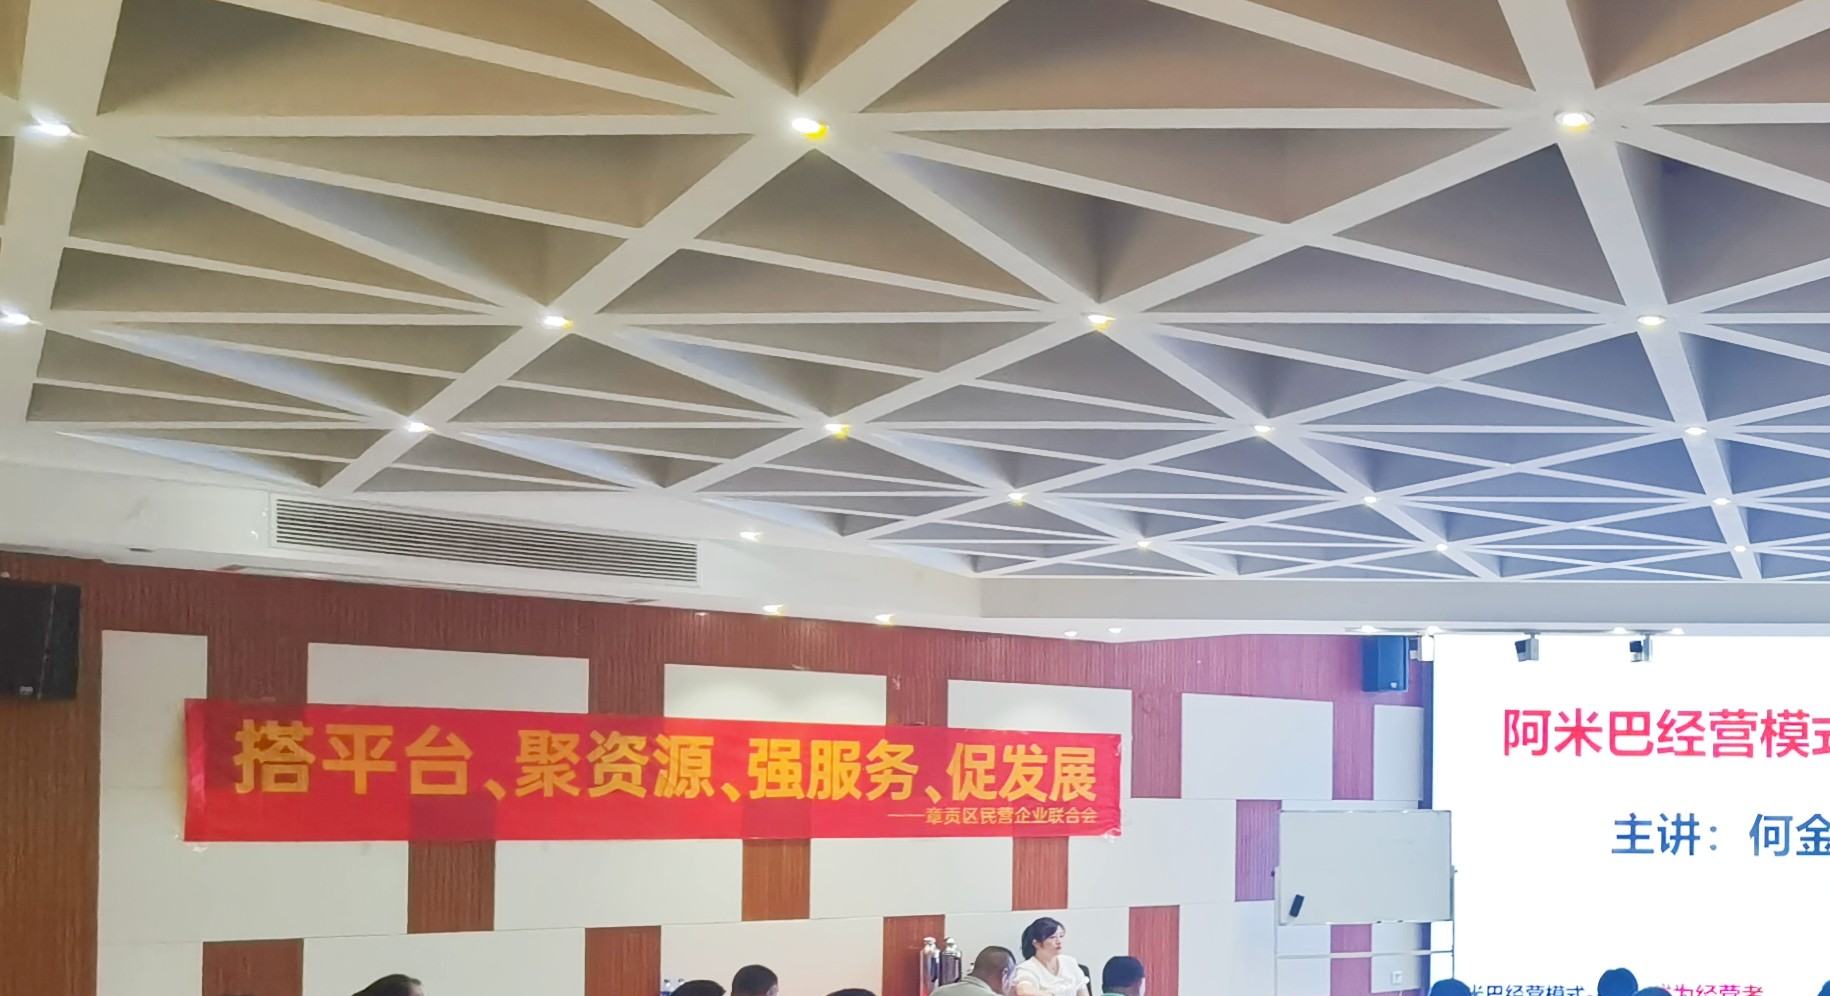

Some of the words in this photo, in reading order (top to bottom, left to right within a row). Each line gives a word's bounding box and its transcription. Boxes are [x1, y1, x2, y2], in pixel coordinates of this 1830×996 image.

[233, 717, 1097, 804] 搭平台、聚资源、强服务、促发展
